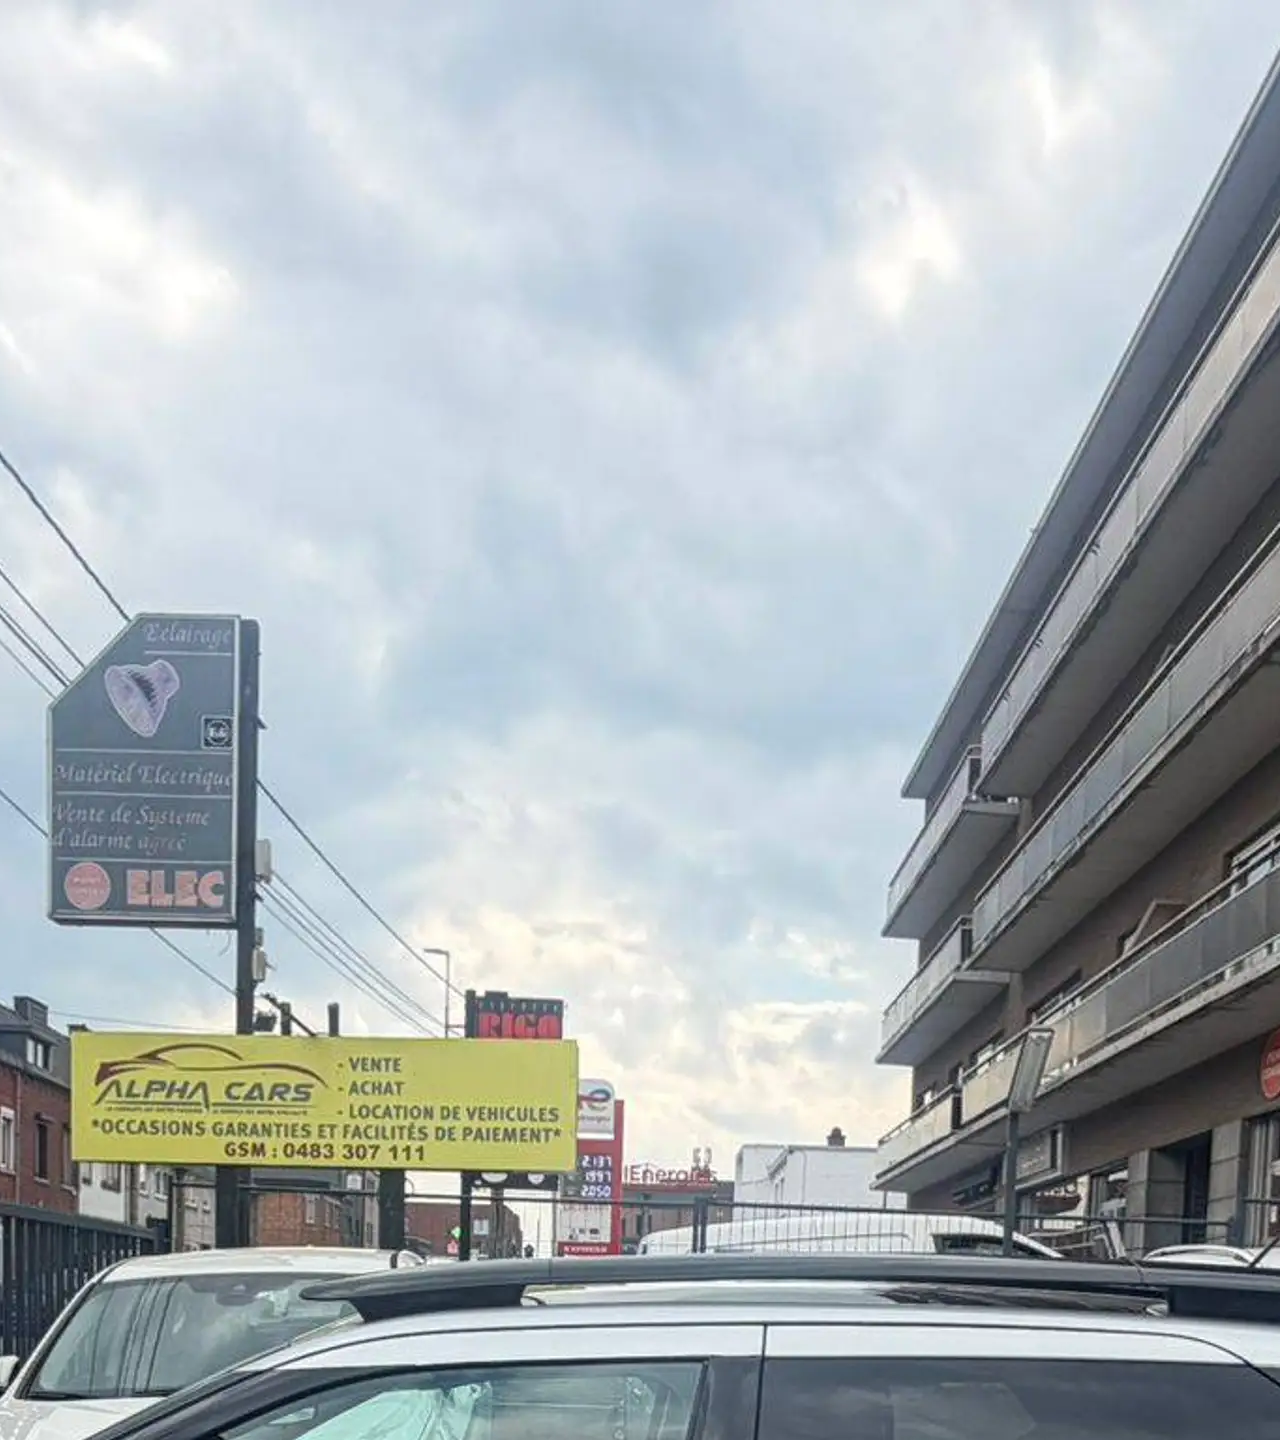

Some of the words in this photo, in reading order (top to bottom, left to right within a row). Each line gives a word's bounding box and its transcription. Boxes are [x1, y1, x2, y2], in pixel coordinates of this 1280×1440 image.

[127, 869, 225, 908] ELEC
[348, 1057, 402, 1073] VENTE
[95, 1079, 210, 1112] ALPHA
[224, 1081, 316, 1103] CARS
[348, 1080, 405, 1097] ACHAT
[348, 1104, 434, 1121] LOCATION
[440, 1105, 461, 1121] DE
[466, 1106, 560, 1123] VEHICULES
[211, 1121, 312, 1139] GARANTIES
[317, 1124, 336, 1140] ET
[434, 1126, 456, 1142] DE
[225, 1142, 267, 1158] GSM
[283, 1143, 335, 1160] 0483
[342, 1144, 381, 1161] 307
[389, 1145, 425, 1162] 111
